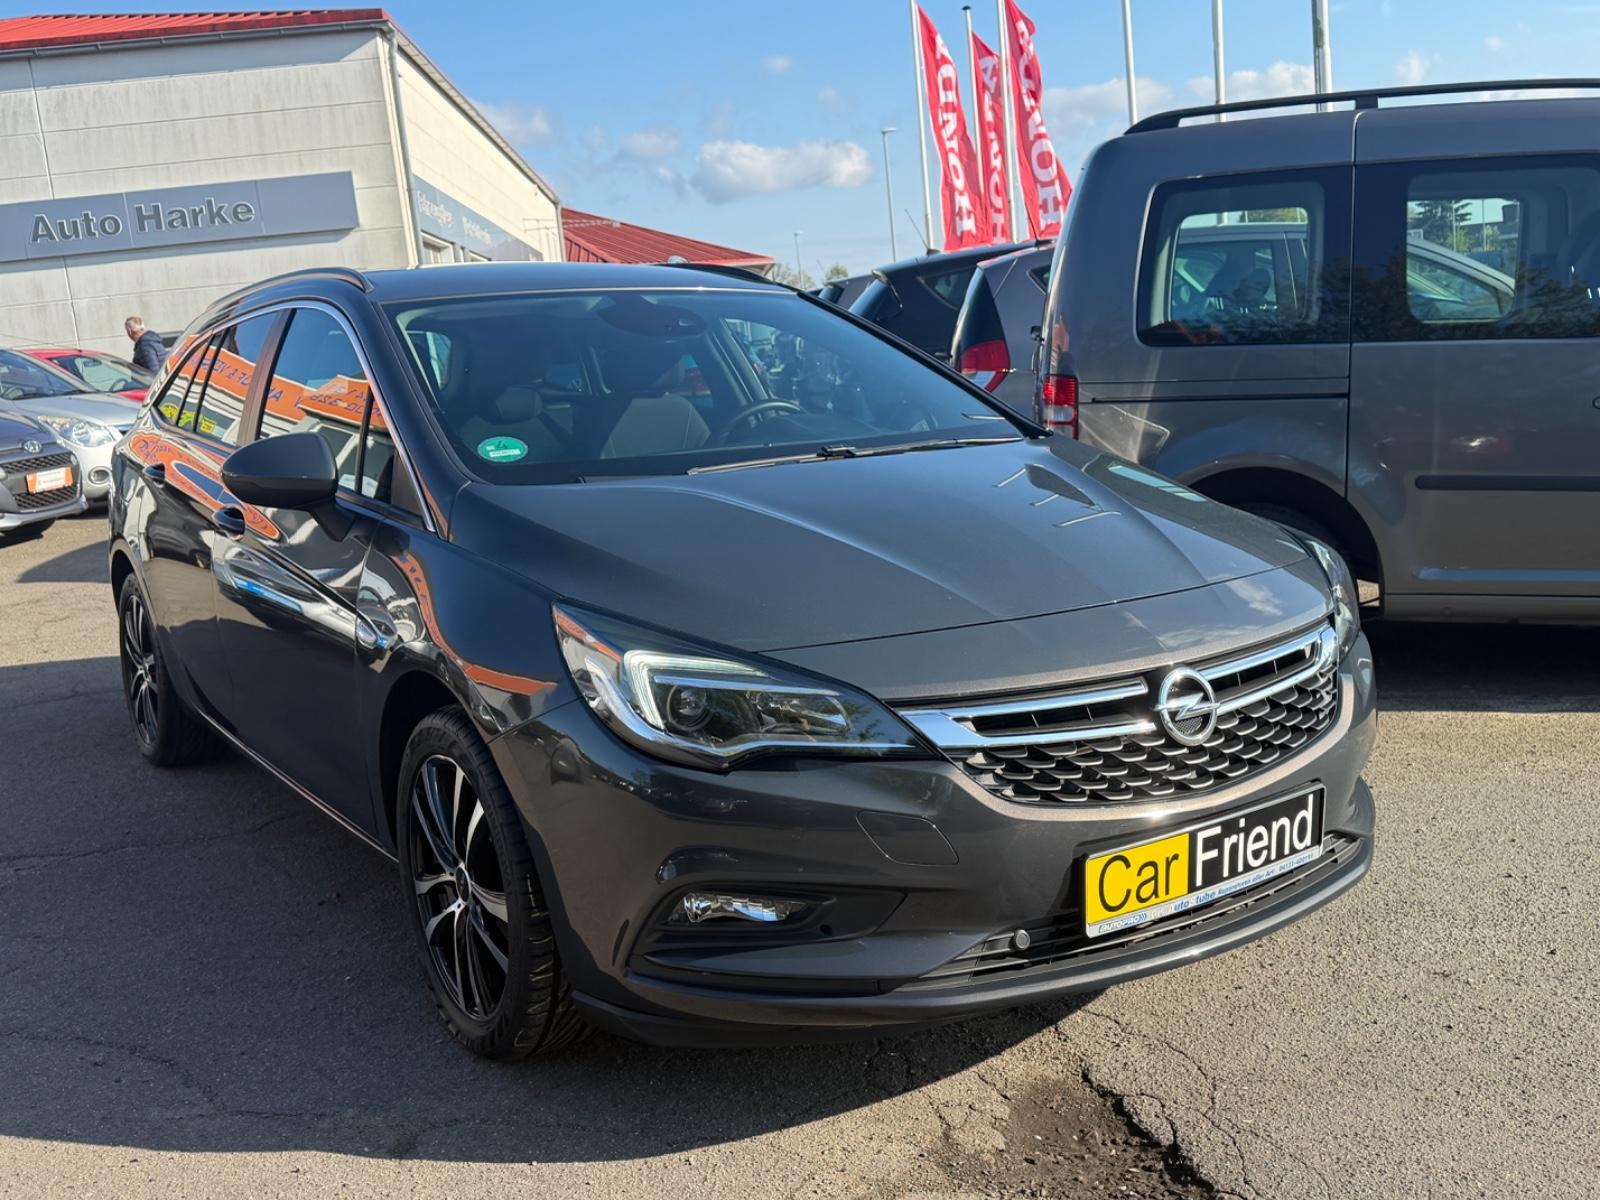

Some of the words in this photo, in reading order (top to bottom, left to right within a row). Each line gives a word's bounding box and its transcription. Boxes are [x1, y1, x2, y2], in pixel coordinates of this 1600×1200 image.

[30, 211, 123, 244] Auto
[133, 197, 256, 234] Harke
[1097, 853, 1181, 914] Car
[1194, 793, 1315, 888] Friend
